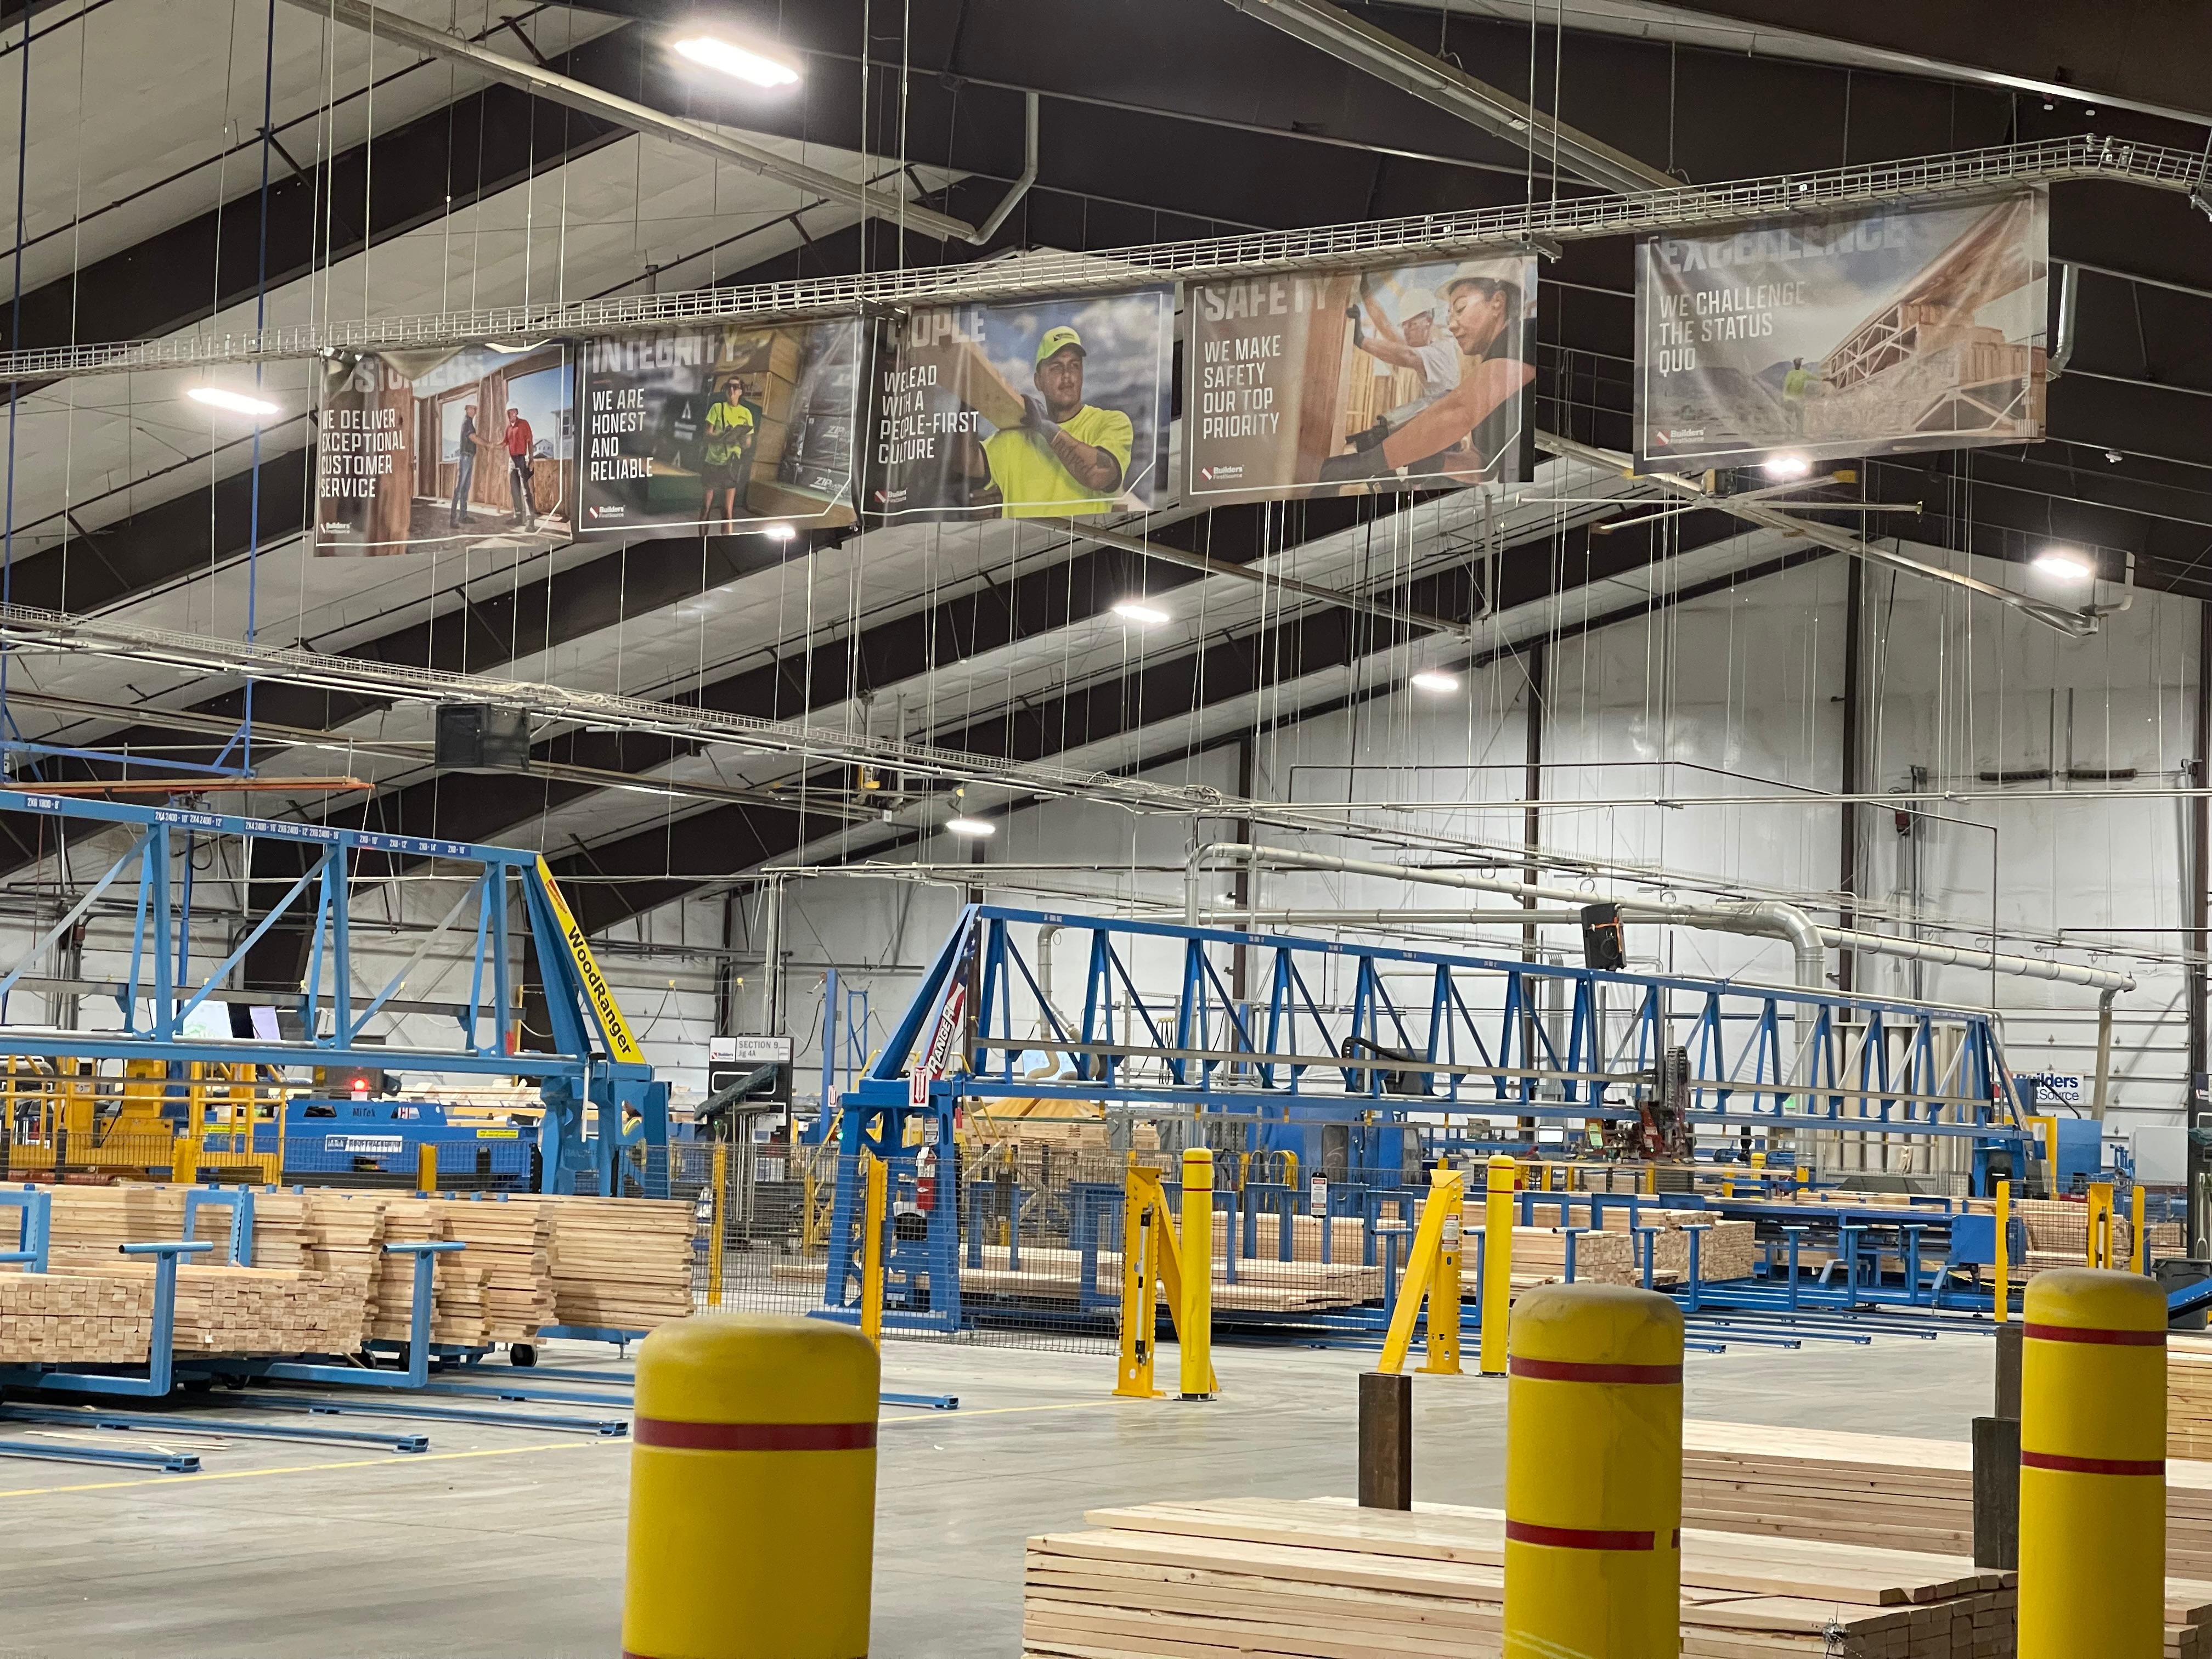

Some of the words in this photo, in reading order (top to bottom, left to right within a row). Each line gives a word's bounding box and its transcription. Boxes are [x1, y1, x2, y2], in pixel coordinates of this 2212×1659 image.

[1205, 272, 1334, 321] SAFETY
[1660, 294, 1689, 319] WE
[1696, 281, 1805, 315] CHALLENGE
[1660, 320, 1694, 346] THE
[1701, 313, 1773, 342] STATUS
[593, 325, 738, 373] INTEGRITY
[1205, 339, 1229, 363] WE
[1235, 335, 1281, 360] MAKE
[1660, 347, 1696, 377] QUO
[884, 372, 906, 392] WE
[1204, 362, 1266, 389] SAFETY
[592, 391, 612, 411] WE
[617, 388, 645, 409] ARE
[915, 391, 924, 411] A
[1203, 391, 1236, 413] OUR
[1242, 387, 1274, 412] TOP
[340, 408, 395, 430] DELIVER
[592, 411, 646, 435] HONEST
[880, 411, 979, 441] PEOPLE-FIRST
[1203, 413, 1279, 439] PRIORITY
[322, 430, 405, 453] EXCEPTIONAL
[591, 437, 619, 458] AND
[878, 438, 935, 464] CULTURE
[321, 454, 392, 475] CUSTOMER
[590, 457, 654, 482] RELIABLE
[320, 477, 376, 498] SERVICE
[814, 477, 833, 487] ZIP
[568, 926, 631, 1054] WoodRanger
[738, 1040, 771, 1048] SECTION
[928, 1003, 955, 1075] RANGER
